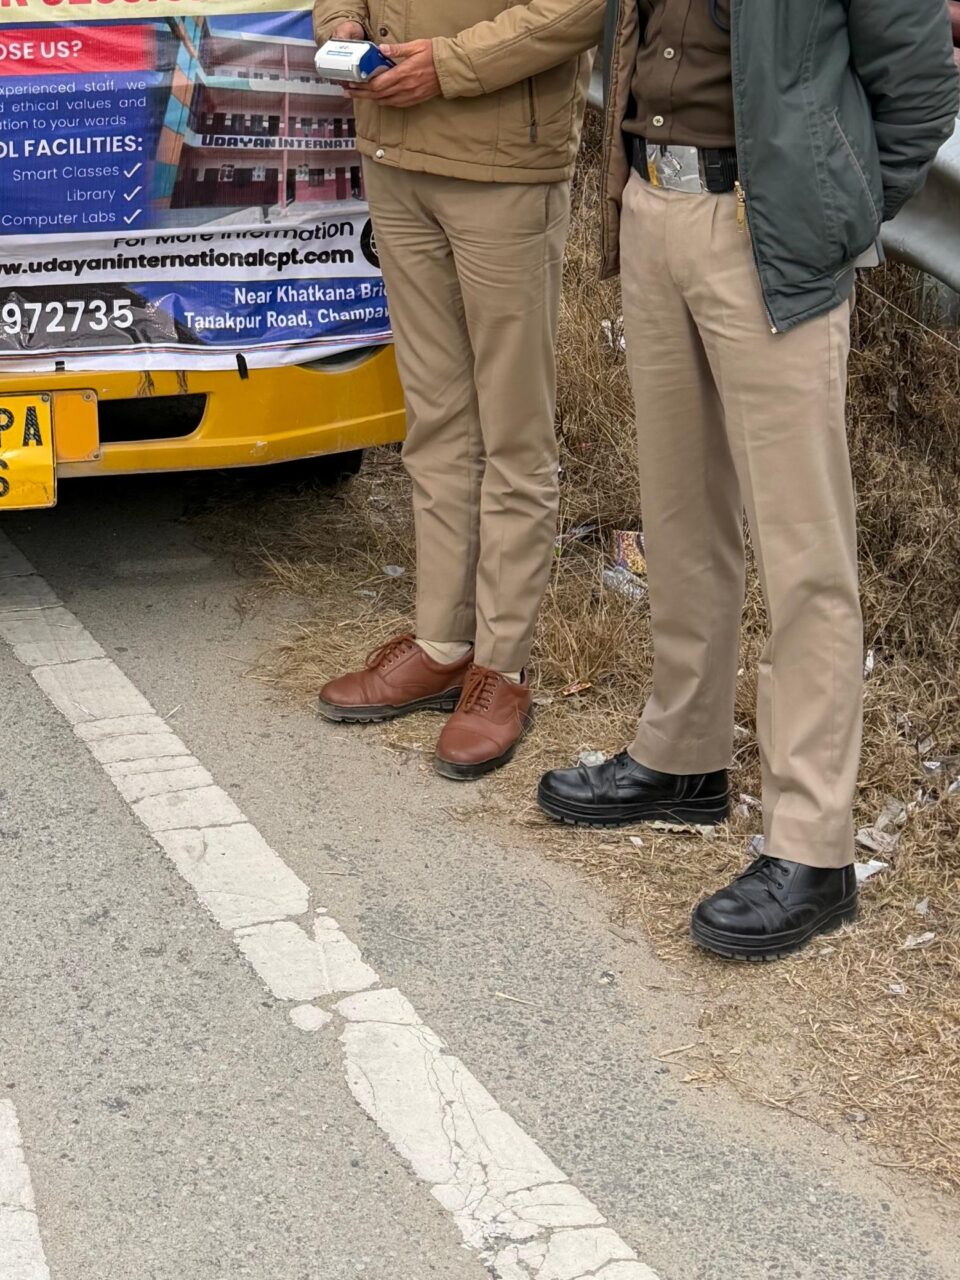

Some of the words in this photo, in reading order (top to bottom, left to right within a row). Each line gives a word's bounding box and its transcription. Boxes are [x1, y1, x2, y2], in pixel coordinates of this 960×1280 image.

[40, 39, 83, 59] US?
[84, 79, 118, 92] staff,
[126, 80, 146, 90] we
[11, 99, 59, 112] ethical
[66, 98, 111, 110] values
[119, 96, 146, 108] and
[33, 118, 46, 129] to
[50, 118, 80, 131] your
[84, 115, 127, 127] wards
[24, 135, 143, 157] FACILITIES:
[201, 134, 276, 148] UDAYAN
[12, 167, 58, 182] Smart
[62, 165, 119, 179] Classes
[67, 188, 116, 204] Library
[1, 213, 78, 230] Computer
[82, 211, 116, 224] Labs
[234, 287, 273, 305] Near
[276, 283, 355, 304] Khatkana
[183, 311, 262, 332] Tanakpur
[266, 310, 313, 328] Road,
